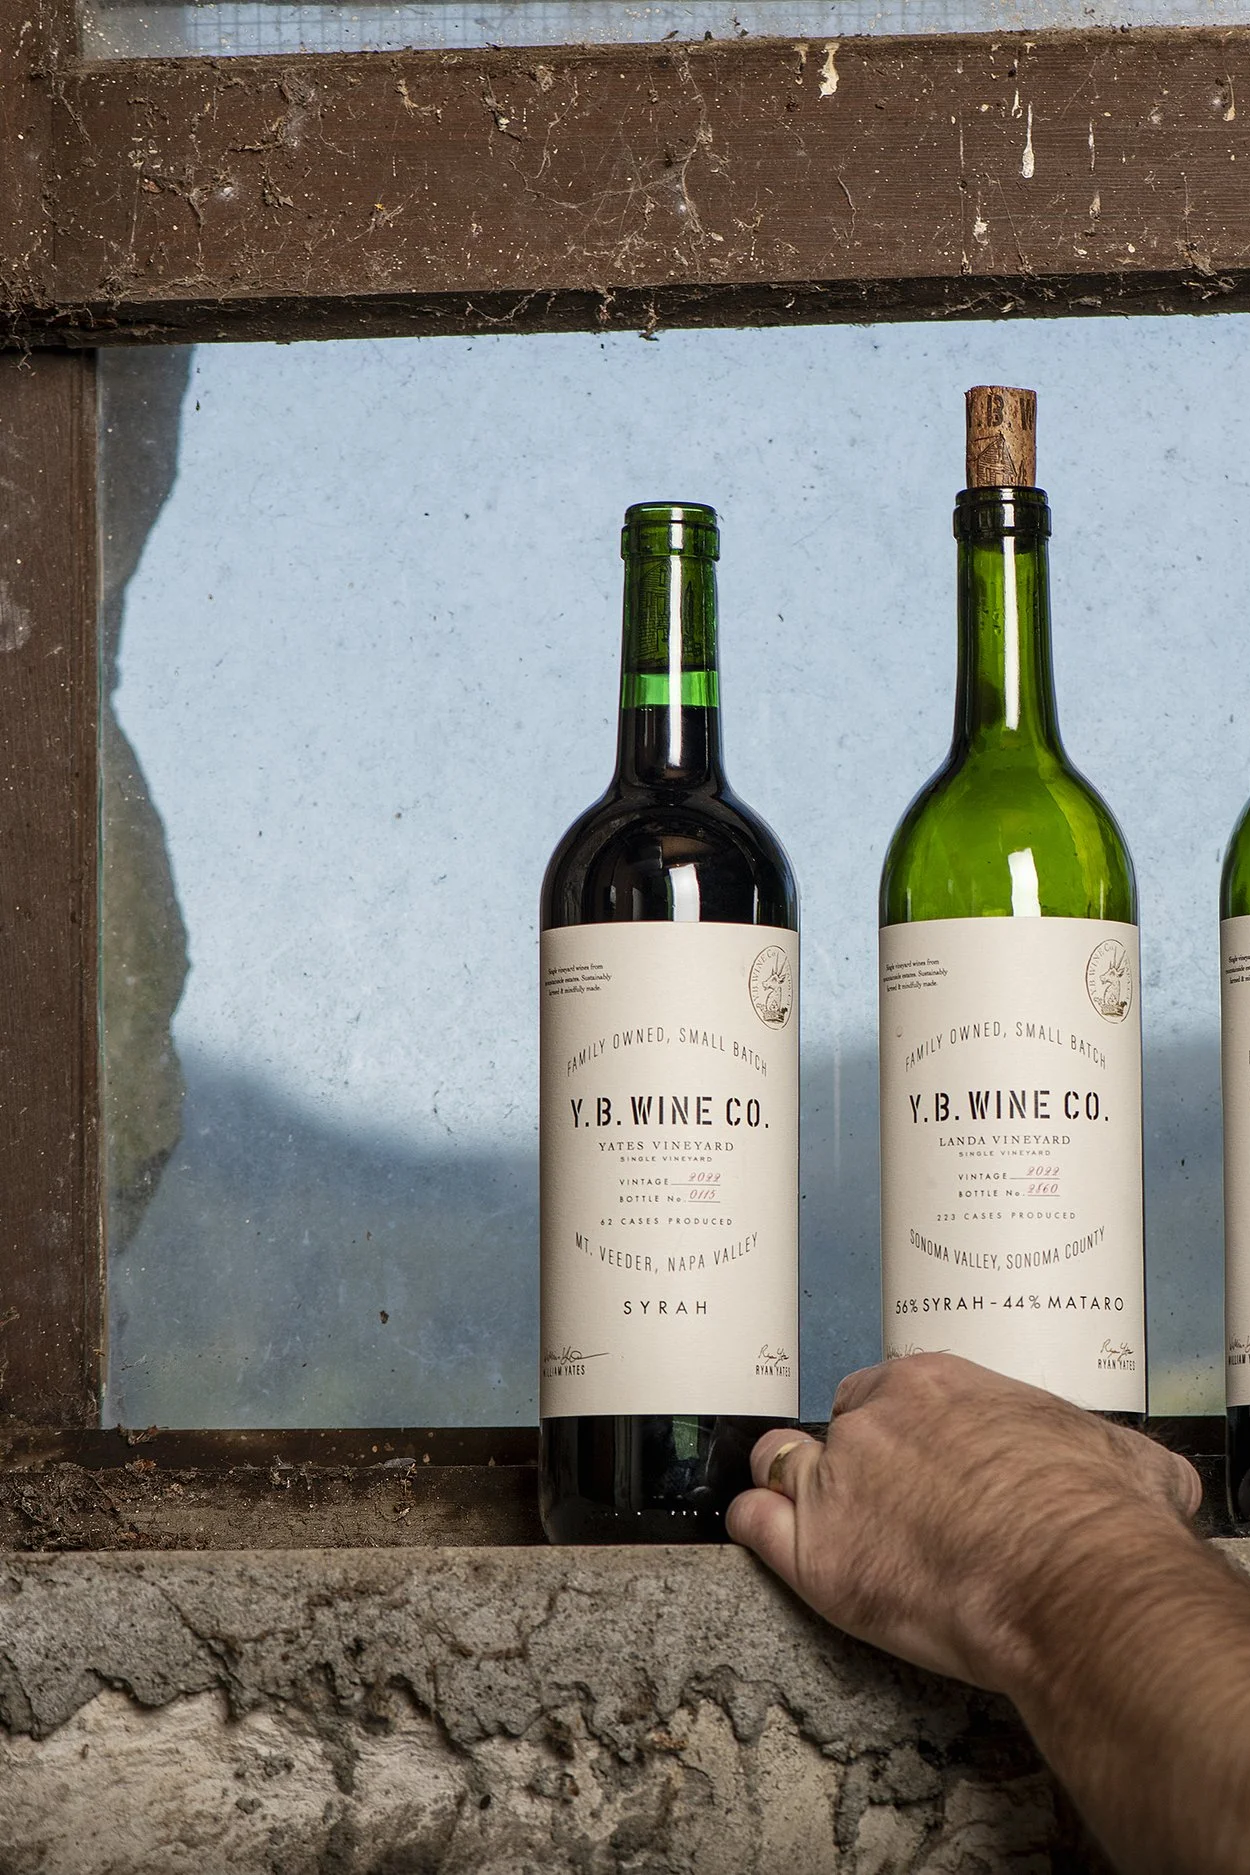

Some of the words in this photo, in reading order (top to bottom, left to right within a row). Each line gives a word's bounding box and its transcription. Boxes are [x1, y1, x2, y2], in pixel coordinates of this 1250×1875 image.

[567, 1038, 606, 1077] FAMILY
[613, 1027, 671, 1049] OWNED,
[679, 1028, 725, 1052] SMALL
[733, 1041, 768, 1077] BATCH
[905, 1034, 943, 1072] FAMILY
[950, 1021, 1007, 1045] OWNED,
[1016, 1022, 1063, 1046] SMALL
[1071, 1035, 1107, 1070] BATCH
[570, 1097, 622, 1129] Y.B.
[630, 1096, 713, 1126] WINE
[726, 1098, 769, 1129] CO.
[909, 1092, 960, 1124] Y.B.
[969, 1090, 1050, 1120] WINE
[1064, 1091, 1109, 1122] CO.
[598, 1142, 644, 1152] YATES
[652, 1141, 734, 1152] VINEYARD
[939, 1136, 986, 1147] LANDA
[992, 1135, 1071, 1146] VINEYARD
[1026, 1165, 1060, 1176] 2022
[619, 1178, 669, 1186] VINTAGE
[688, 1171, 721, 1183] 2022
[619, 1195, 659, 1203] BOTTLE
[667, 1195, 687, 1203] No.
[689, 1189, 717, 1200] 0115
[958, 1190, 998, 1198] BOTTLE
[600, 1218, 613, 1226] 62
[621, 1217, 659, 1226] CASES
[668, 1217, 733, 1226] PRODUCED
[936, 1213, 956, 1221] 223
[964, 1212, 1002, 1220] CASES
[1011, 1211, 1076, 1220] PRODUCED
[575, 1232, 593, 1256] MT.
[599, 1246, 659, 1274] VEEDER,
[668, 1254, 705, 1272] NAPA
[713, 1232, 758, 1265] VALLEY
[909, 1229, 949, 1263] SONOMA
[953, 1249, 1001, 1271] VALLEY,
[1006, 1248, 1060, 1270] SONOMA
[1065, 1226, 1105, 1260] COUNTY
[623, 1300, 707, 1315] SYRAH
[895, 1300, 918, 1315] 56%
[922, 1296, 983, 1312] SYRAH
[1003, 1295, 1041, 1310] 44%
[1048, 1295, 1124, 1312] MATARO
[565, 1365, 585, 1376] YATES
[755, 1364, 773, 1376] RYAN
[1098, 1359, 1116, 1370] RYAN
